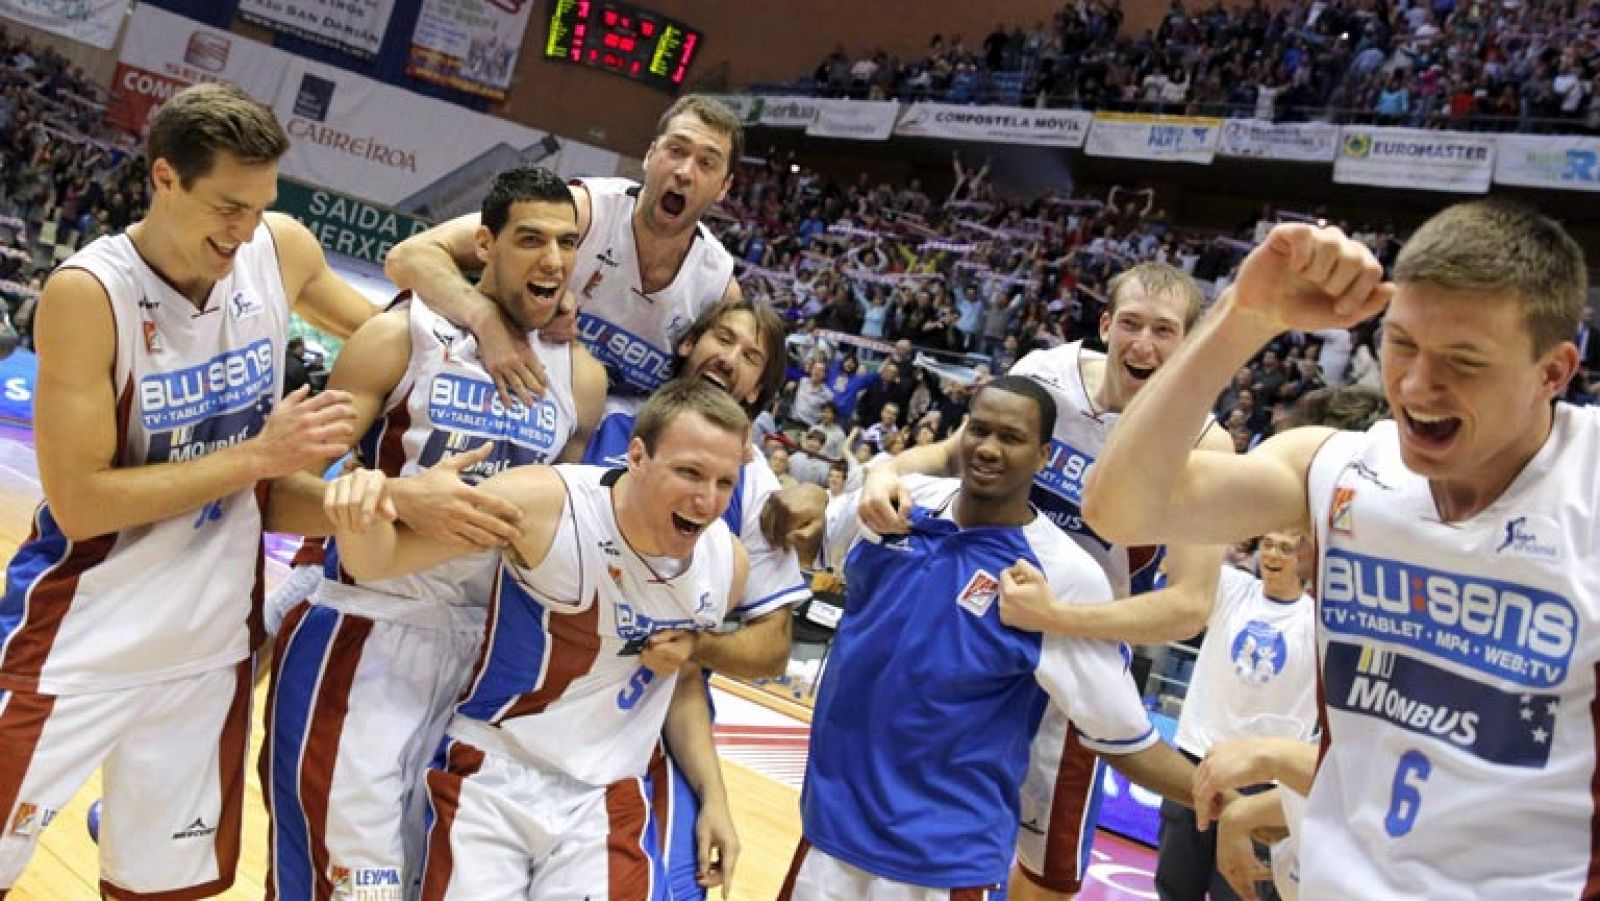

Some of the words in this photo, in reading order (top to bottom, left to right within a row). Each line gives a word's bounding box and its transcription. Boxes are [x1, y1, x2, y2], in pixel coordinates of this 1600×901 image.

[935, 112, 1029, 130] COMPOSTELA
[1373, 141, 1487, 162] EUROMASTER
[309, 191, 397, 237] SAIDA
[1323, 606, 1347, 622] TV
[1358, 613, 1424, 640] TABLET
[1436, 631, 1469, 656] MP4
[1484, 645, 1563, 684] WEB:TV
[1347, 675, 1480, 746] MONBUS
[1384, 748, 1432, 837] 6
